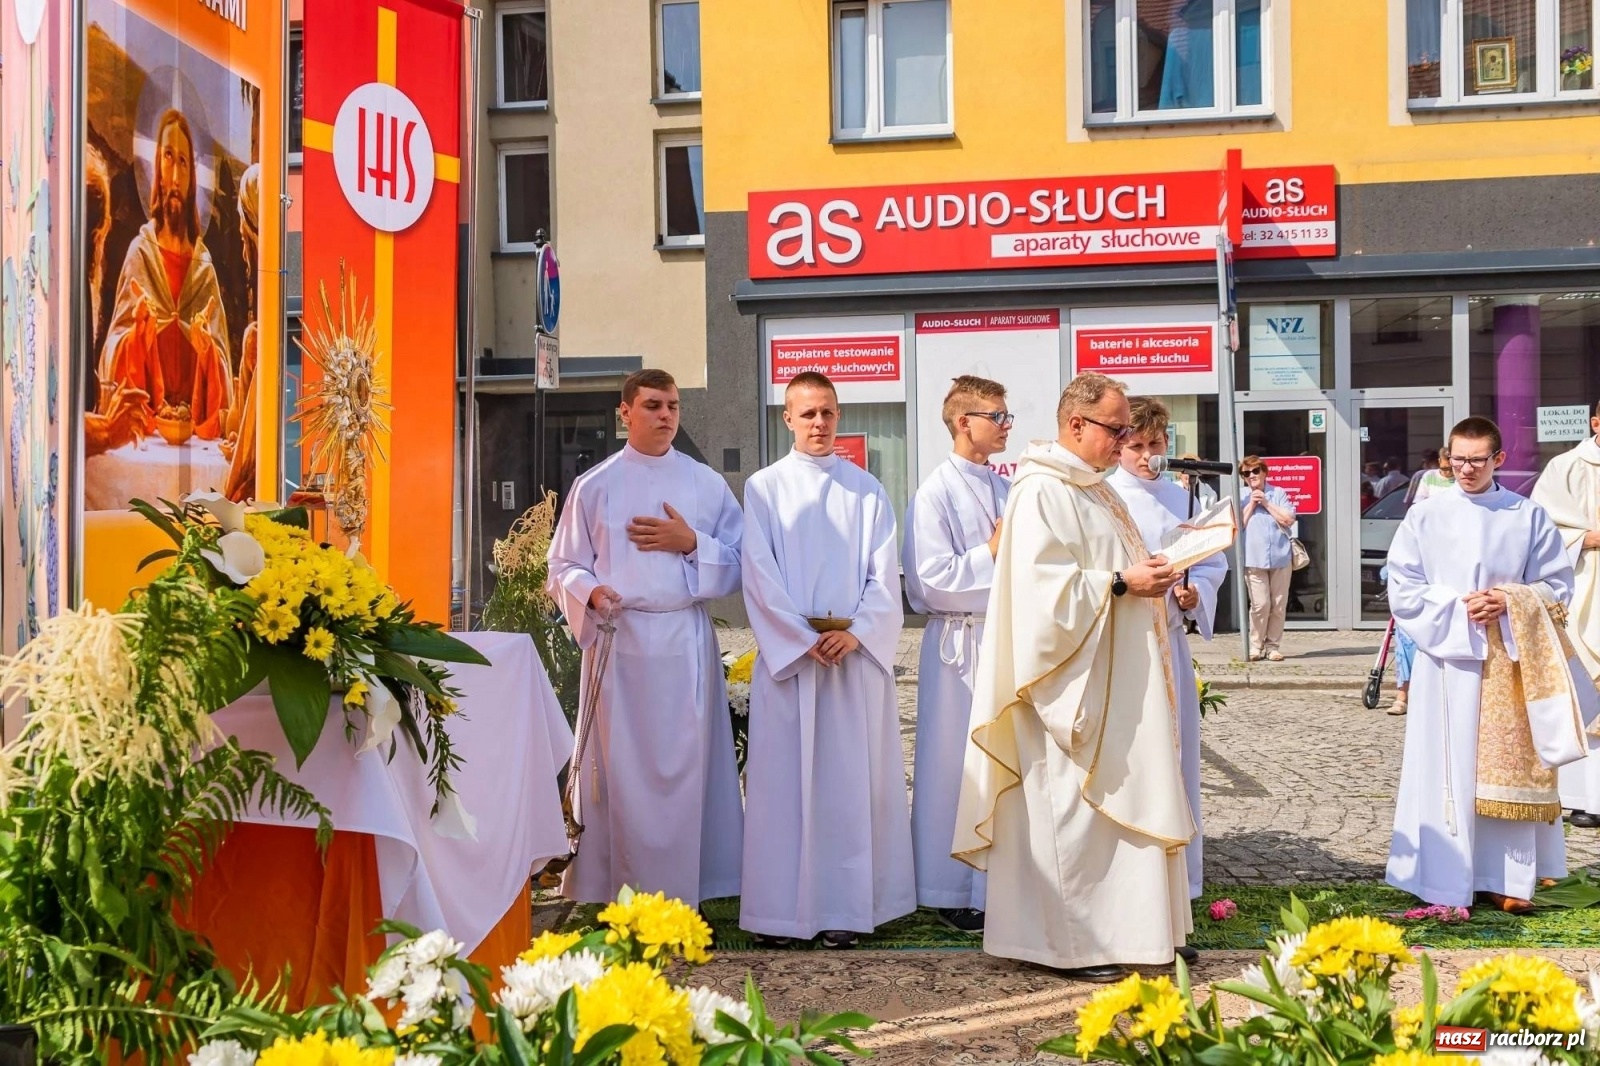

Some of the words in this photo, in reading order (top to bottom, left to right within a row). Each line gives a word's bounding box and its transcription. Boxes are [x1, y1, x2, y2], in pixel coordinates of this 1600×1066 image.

[358, 106, 417, 204] IHS
[1265, 177, 1305, 204] as
[875, 184, 1166, 231] AUDIO-SŁUCH
[1242, 204, 1328, 218] AUDIO-SŁUCH
[766, 199, 863, 266] as
[1260, 230, 1274, 240] 32
[1277, 228, 1298, 239] 415
[1301, 228, 1312, 238] 11
[1315, 227, 1329, 238] 33
[1013, 232, 1092, 256] aparaty
[1101, 229, 1200, 249] słuchowe
[922, 318, 981, 328] AUDIO-SŁUCH
[990, 316, 1016, 325] APARATY
[1018, 314, 1051, 324] SŁUCHOWE
[1266, 317, 1305, 334] NFZ
[1090, 338, 1134, 350] baterie
[1135, 337, 1140, 348] i
[1142, 336, 1200, 348] akcesoria
[777, 349, 831, 360] bezpłatne
[833, 346, 894, 358] testowanie
[1100, 354, 1148, 365] badanie
[1149, 352, 1190, 363] słuchu
[777, 363, 829, 377] aparatów
[831, 361, 895, 375] słuchowych
[1573, 408, 1585, 416] DO
